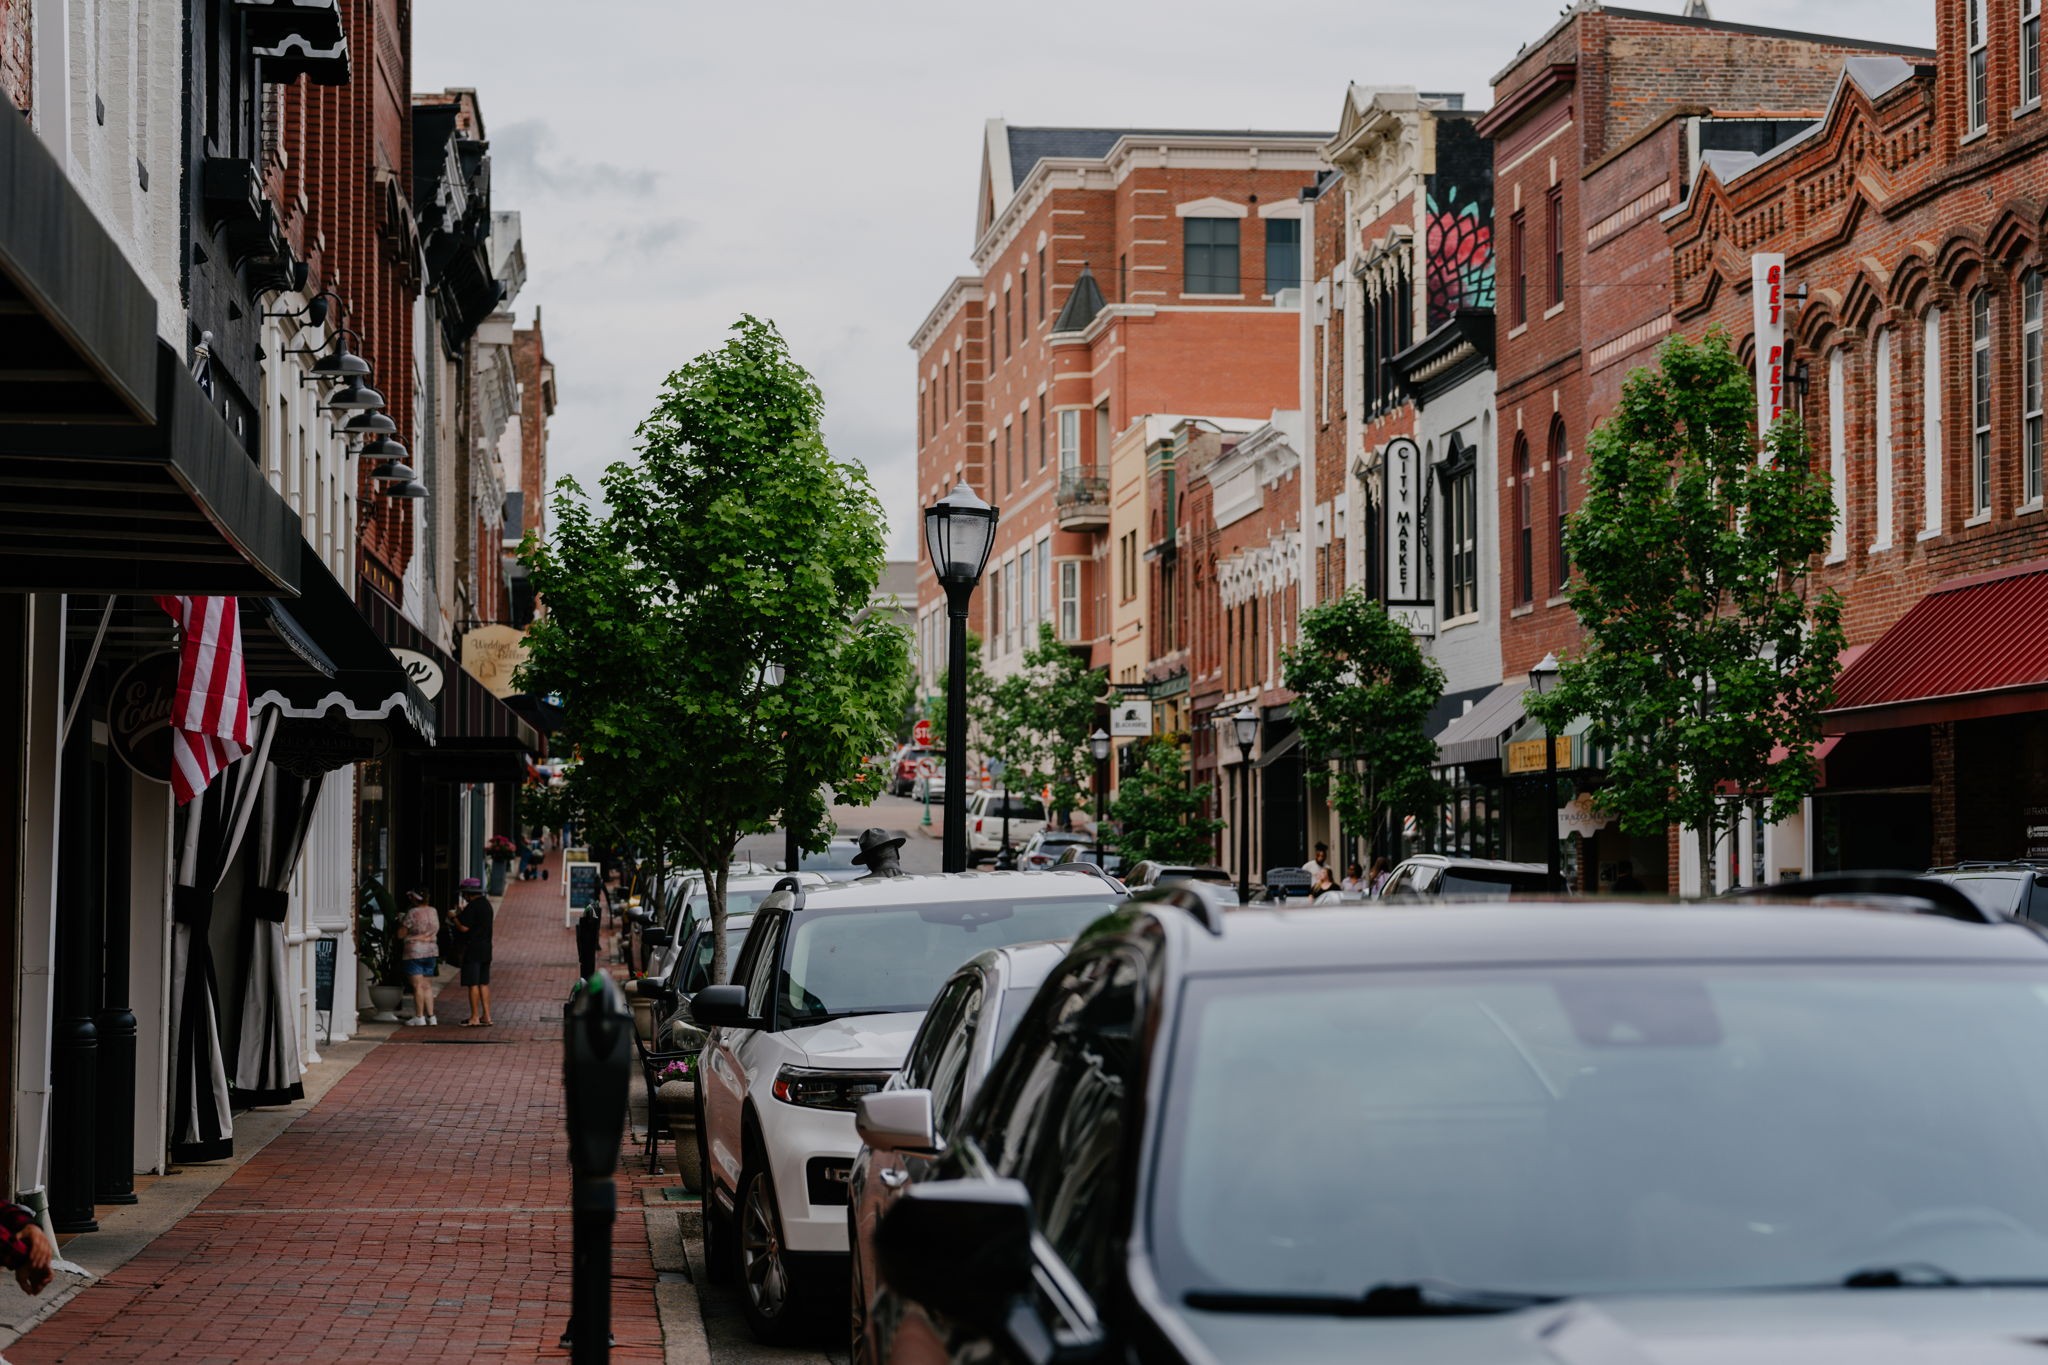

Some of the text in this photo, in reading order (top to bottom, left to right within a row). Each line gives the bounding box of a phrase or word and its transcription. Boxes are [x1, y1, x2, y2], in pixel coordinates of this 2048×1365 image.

[1767, 265, 1781, 324] GET
[1397, 447, 1411, 595] CITY MARKET
